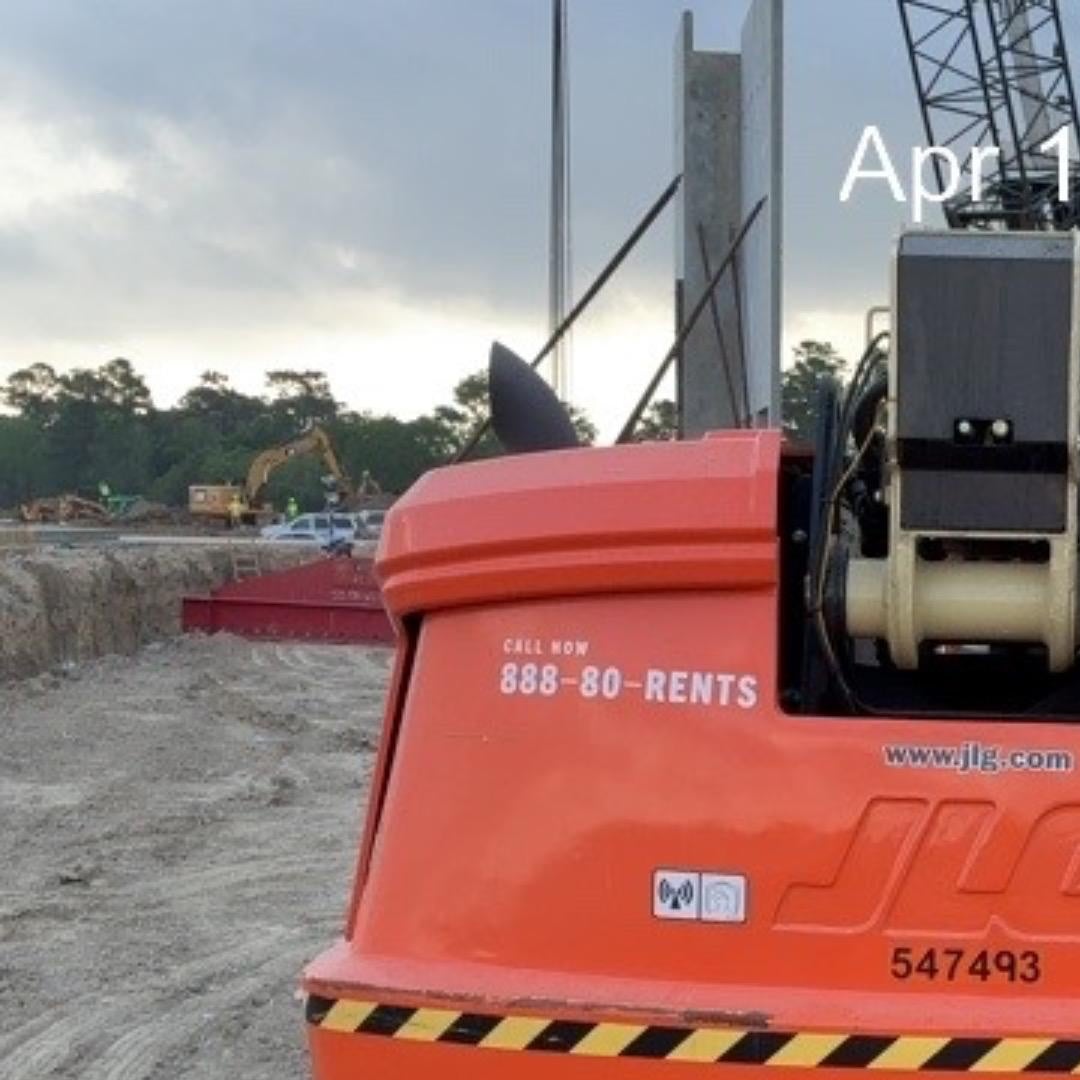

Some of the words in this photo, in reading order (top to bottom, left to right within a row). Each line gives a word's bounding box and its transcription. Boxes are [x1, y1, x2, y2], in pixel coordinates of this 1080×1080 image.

[503, 638, 543, 655] CALL
[551, 641, 589, 656] NOW
[500, 662, 758, 709] 888-80-RENTS
[884, 743, 1073, 772] www.jlg.com
[892, 946, 1042, 983] 547493
